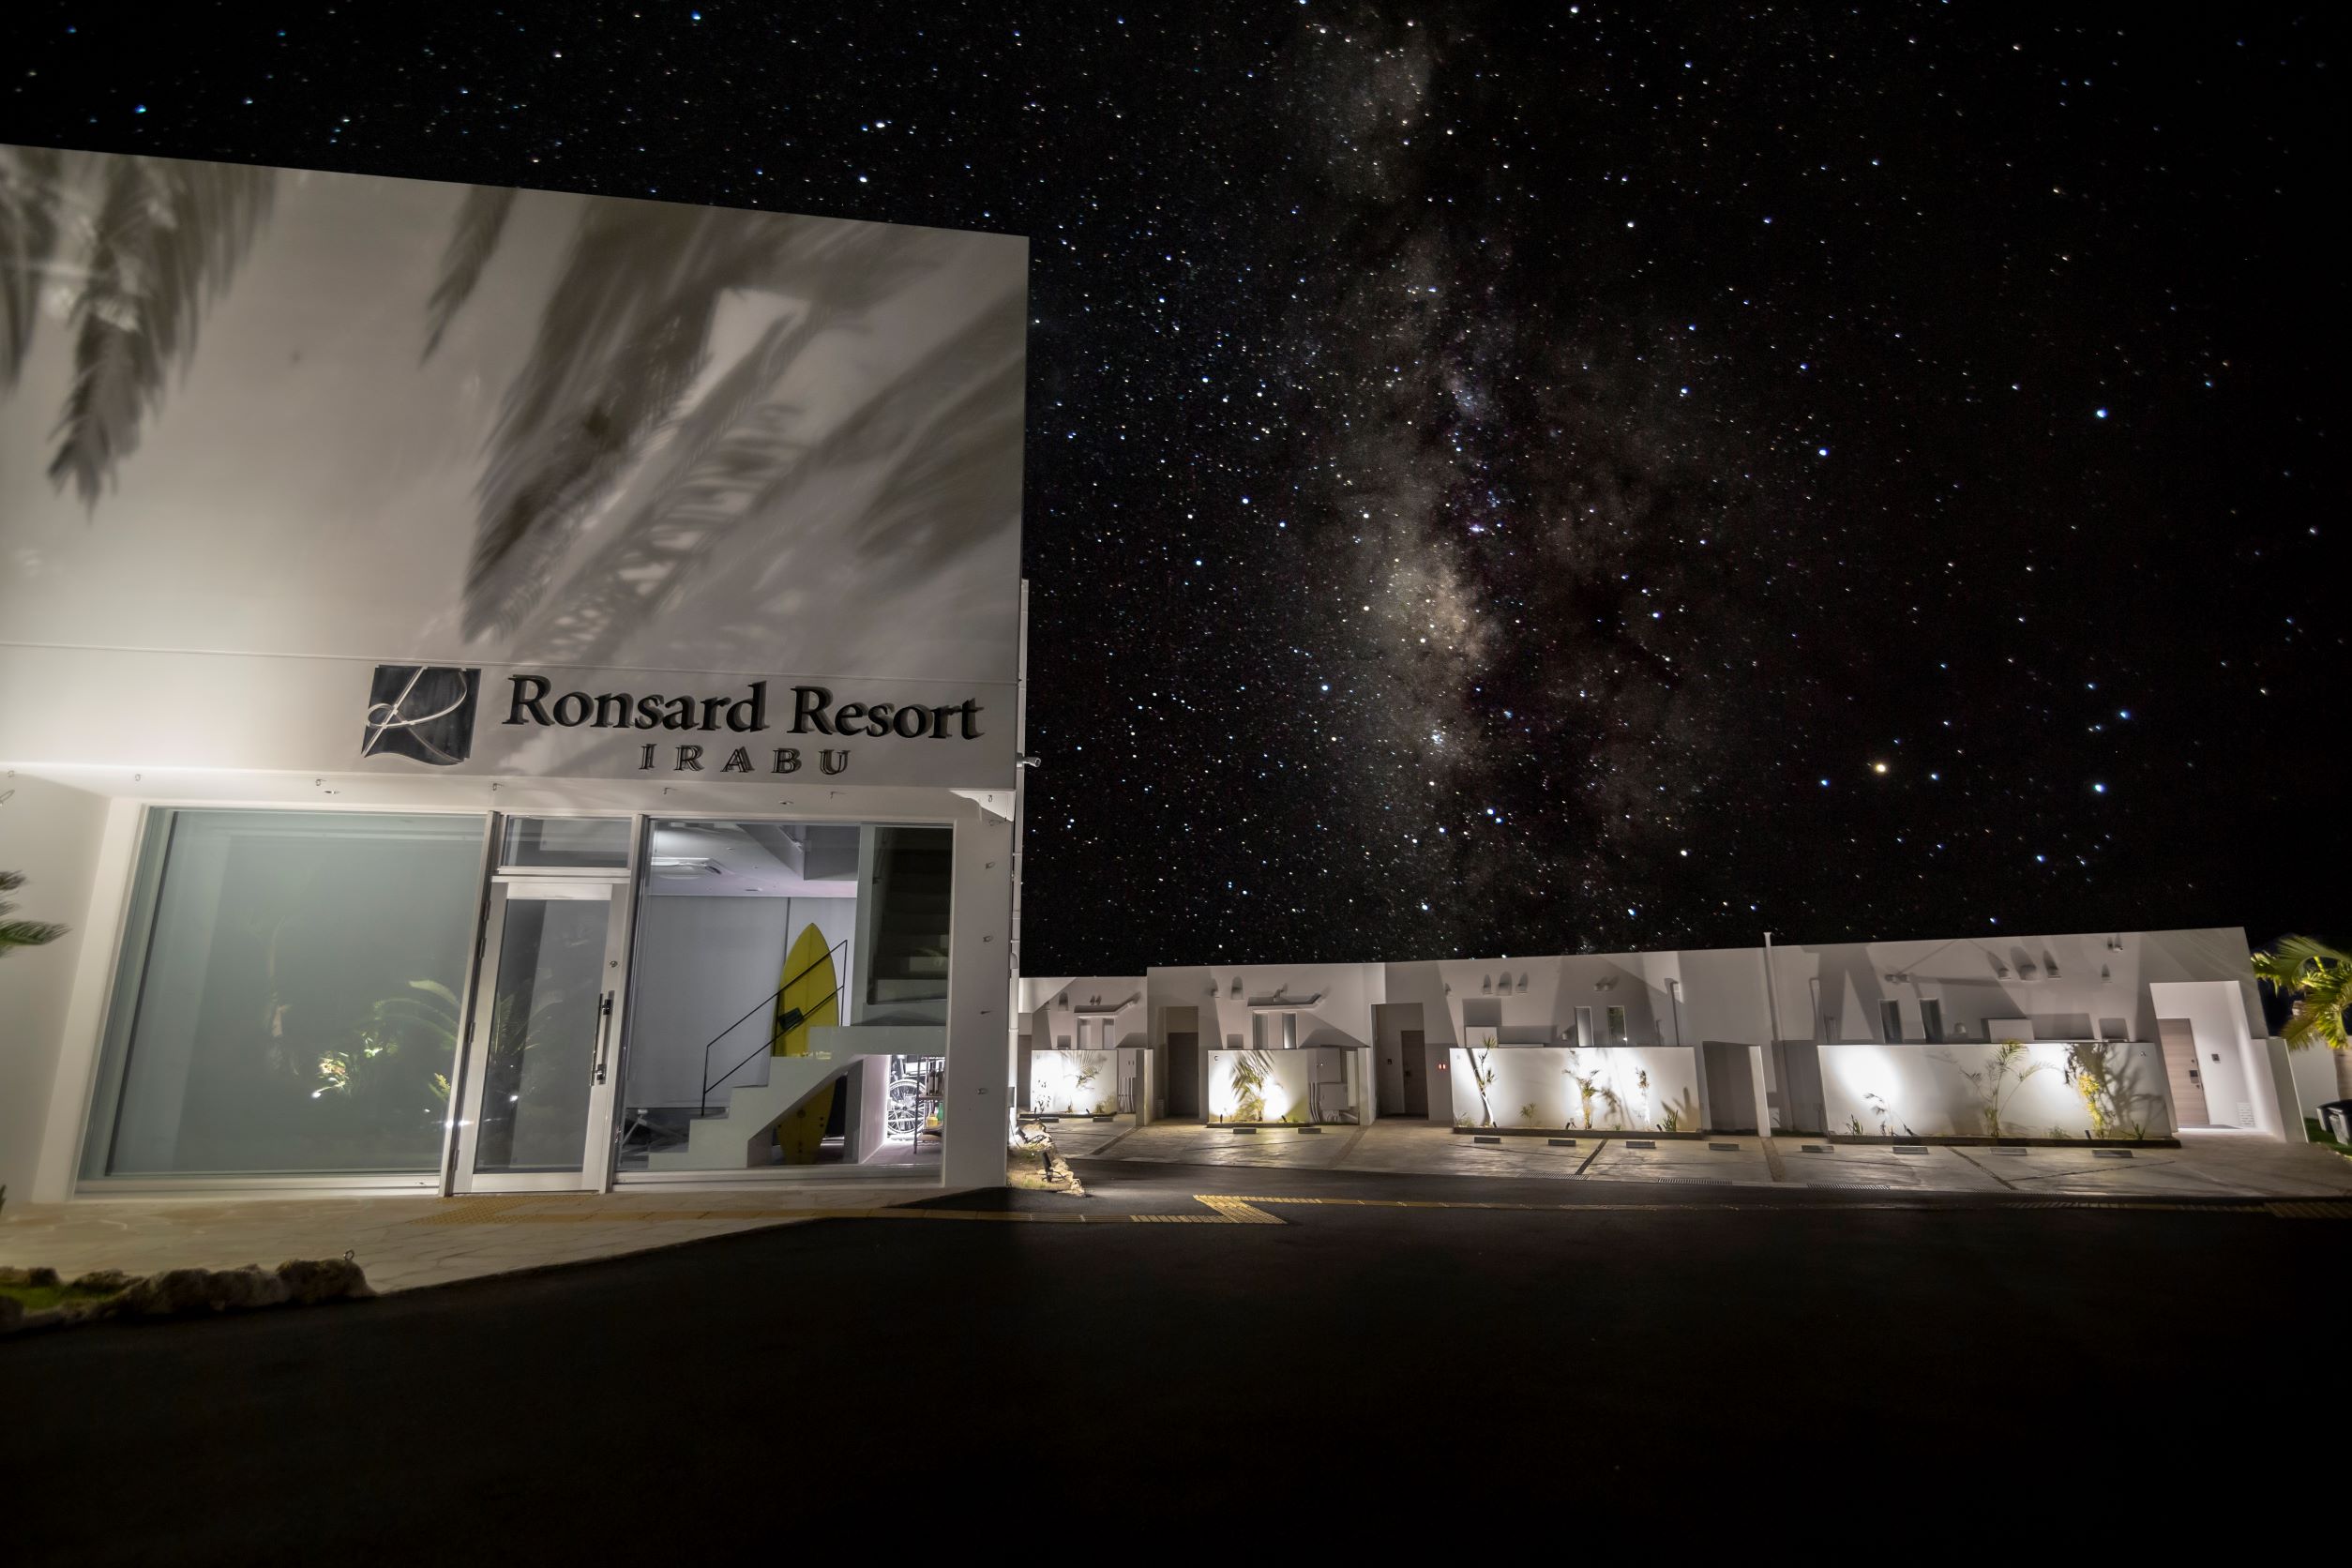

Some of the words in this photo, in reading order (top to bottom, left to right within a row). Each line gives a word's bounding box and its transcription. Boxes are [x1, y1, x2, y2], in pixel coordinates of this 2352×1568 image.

[502, 674, 770, 732] Ronsard
[787, 686, 985, 740] Resort
[639, 744, 851, 776] IRABU
